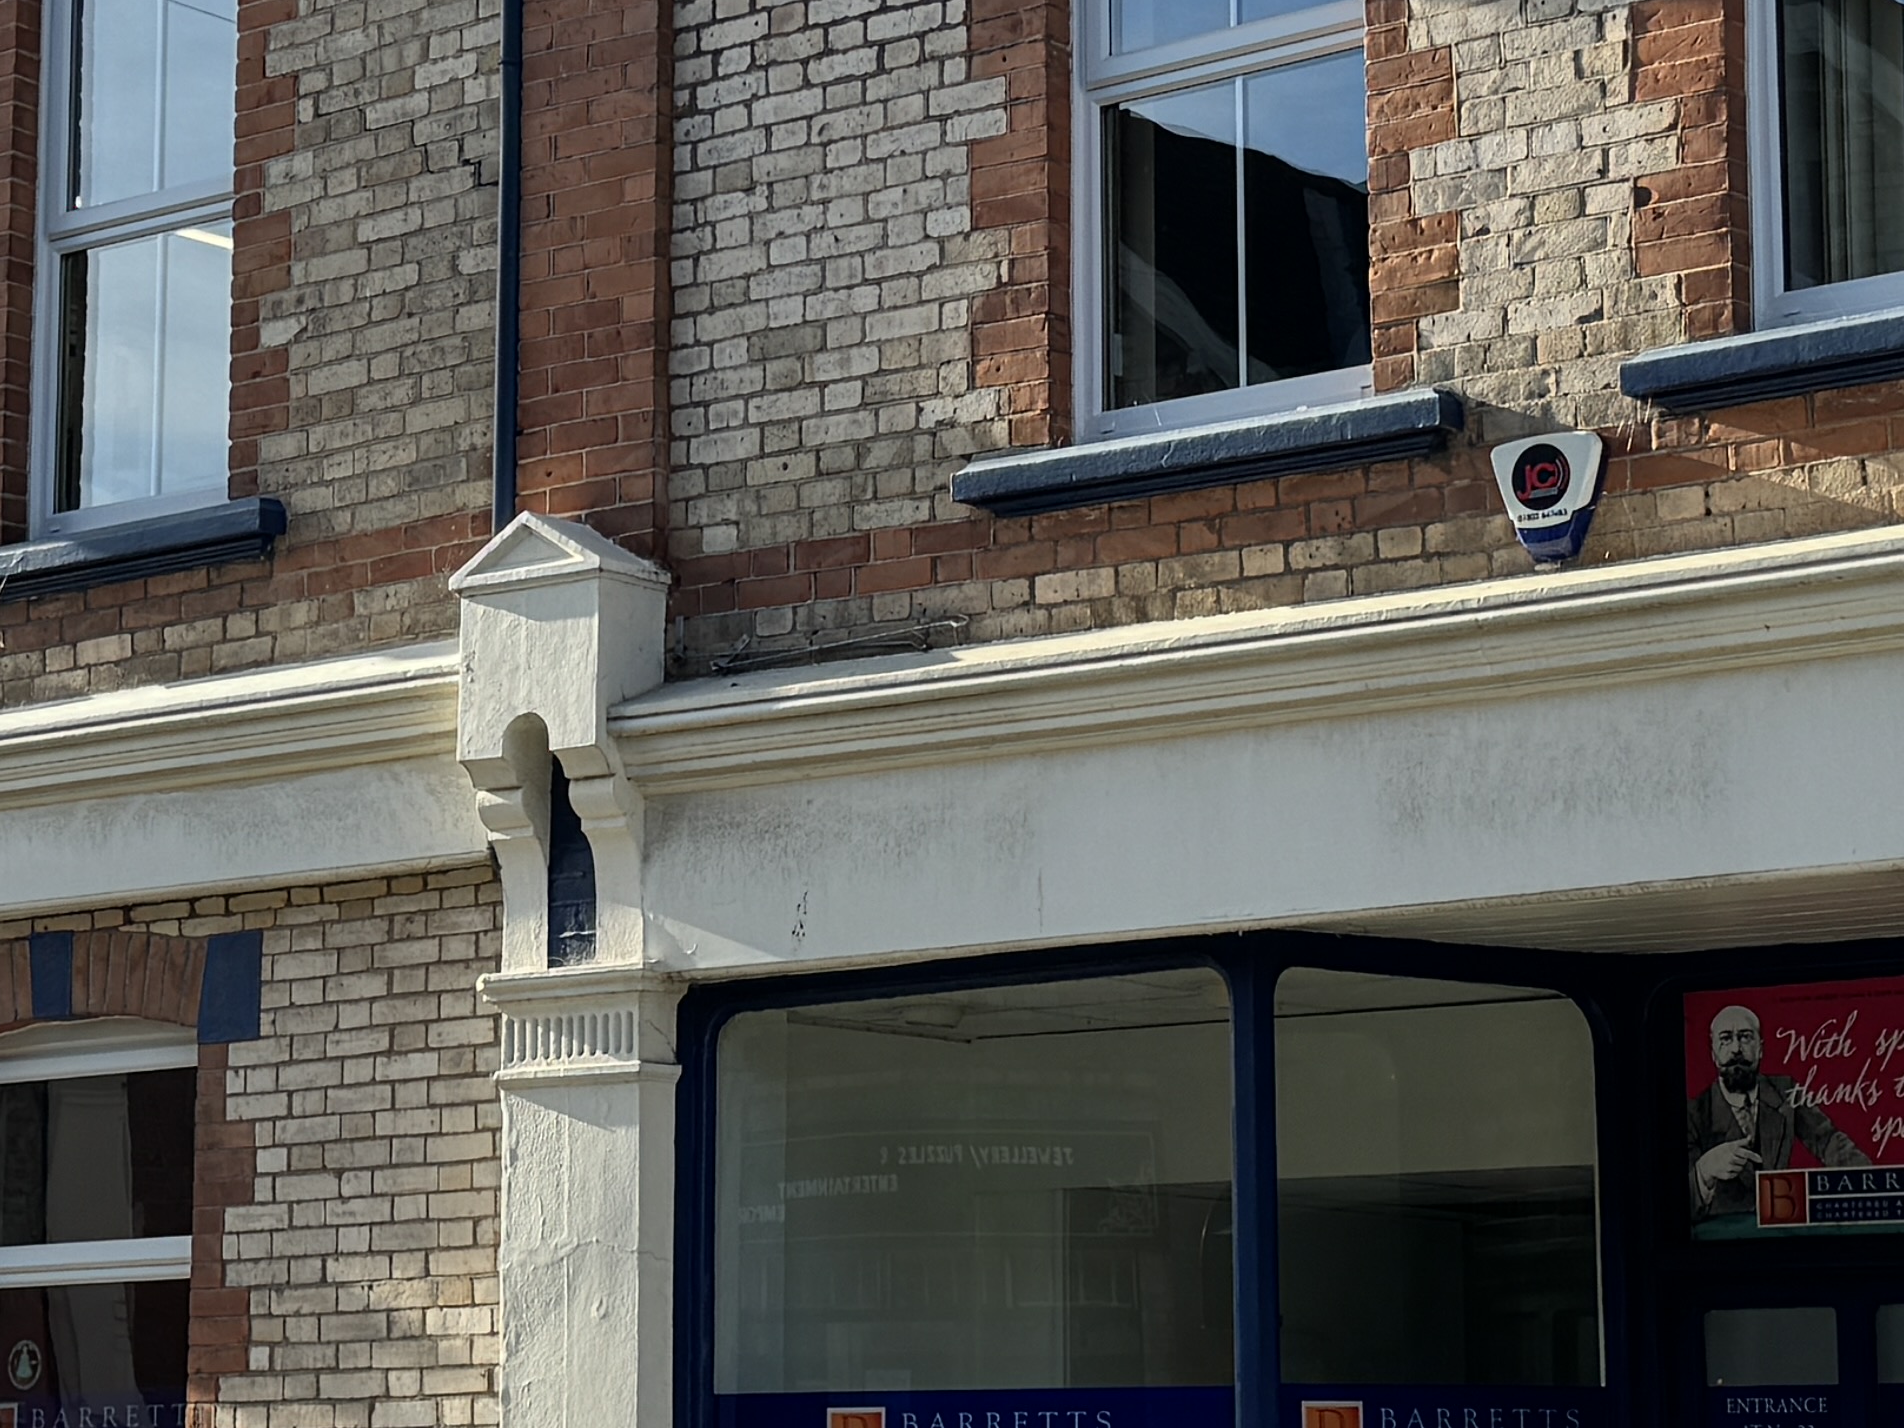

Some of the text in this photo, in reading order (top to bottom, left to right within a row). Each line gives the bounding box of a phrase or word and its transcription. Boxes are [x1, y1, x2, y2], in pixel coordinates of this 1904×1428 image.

[1776, 1010, 1858, 1064] With
[1785, 1057, 1882, 1112] thanks
[1726, 1397, 1828, 1414] ENTRANCE
